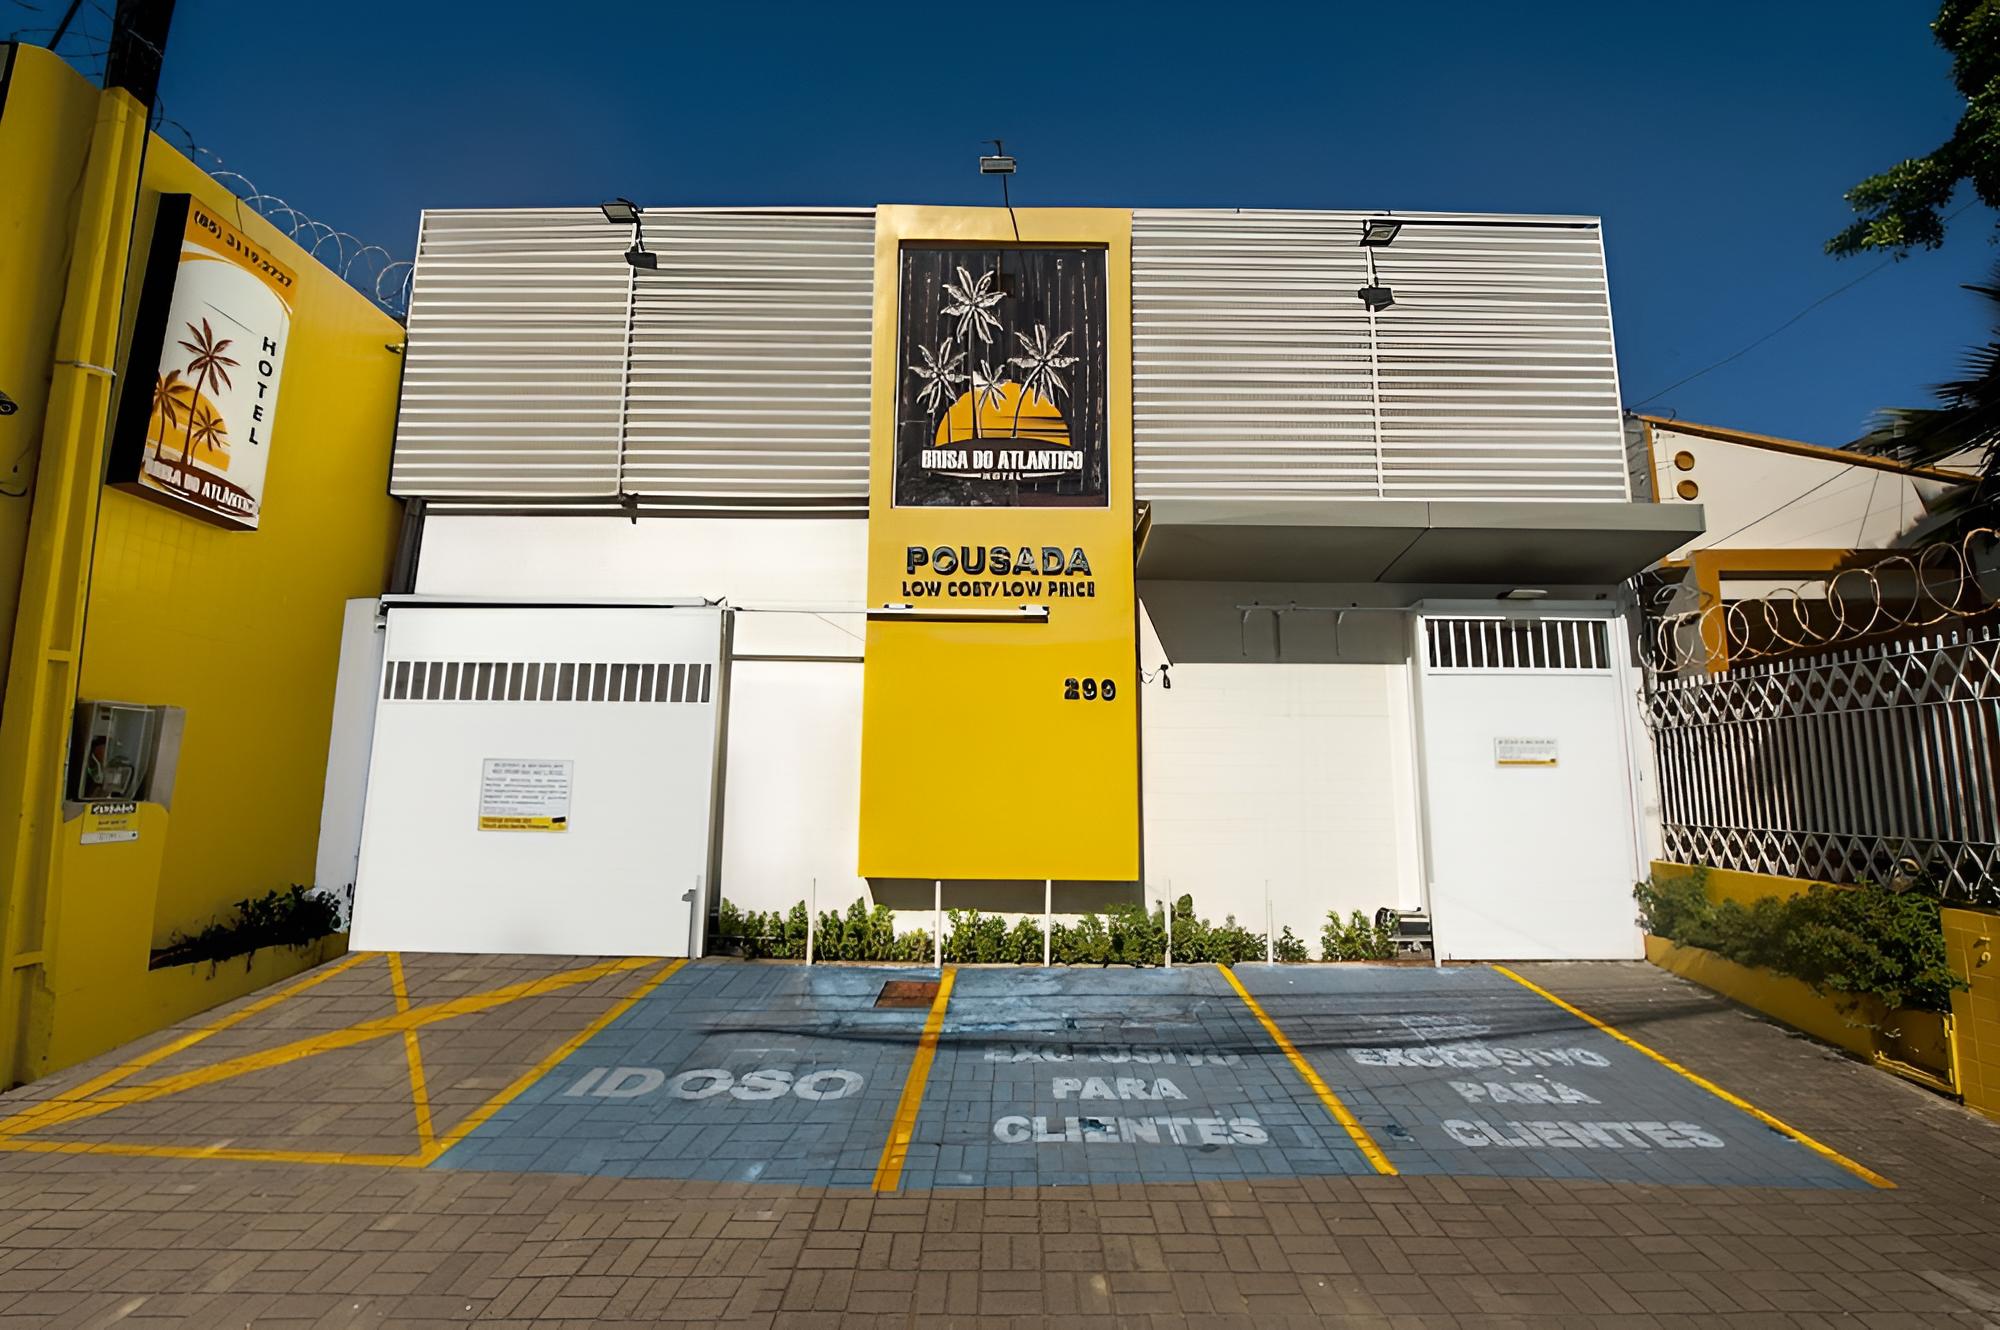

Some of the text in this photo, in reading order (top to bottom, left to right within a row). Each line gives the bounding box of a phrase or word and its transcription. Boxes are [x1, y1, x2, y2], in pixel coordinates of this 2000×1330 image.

[248, 336, 276, 445] HOTEL
[921, 450, 968, 468] BRISA
[973, 450, 994, 469] DO
[906, 546, 1092, 576] POUSADA
[902, 581, 942, 597] LOW
[563, 1067, 865, 1101] IDOSO
[1052, 1076, 1189, 1100] PARA
[1448, 1080, 1602, 1104] PARA
[992, 1115, 1270, 1145] CLIENTES
[1440, 1119, 1726, 1148] CLIENTES
